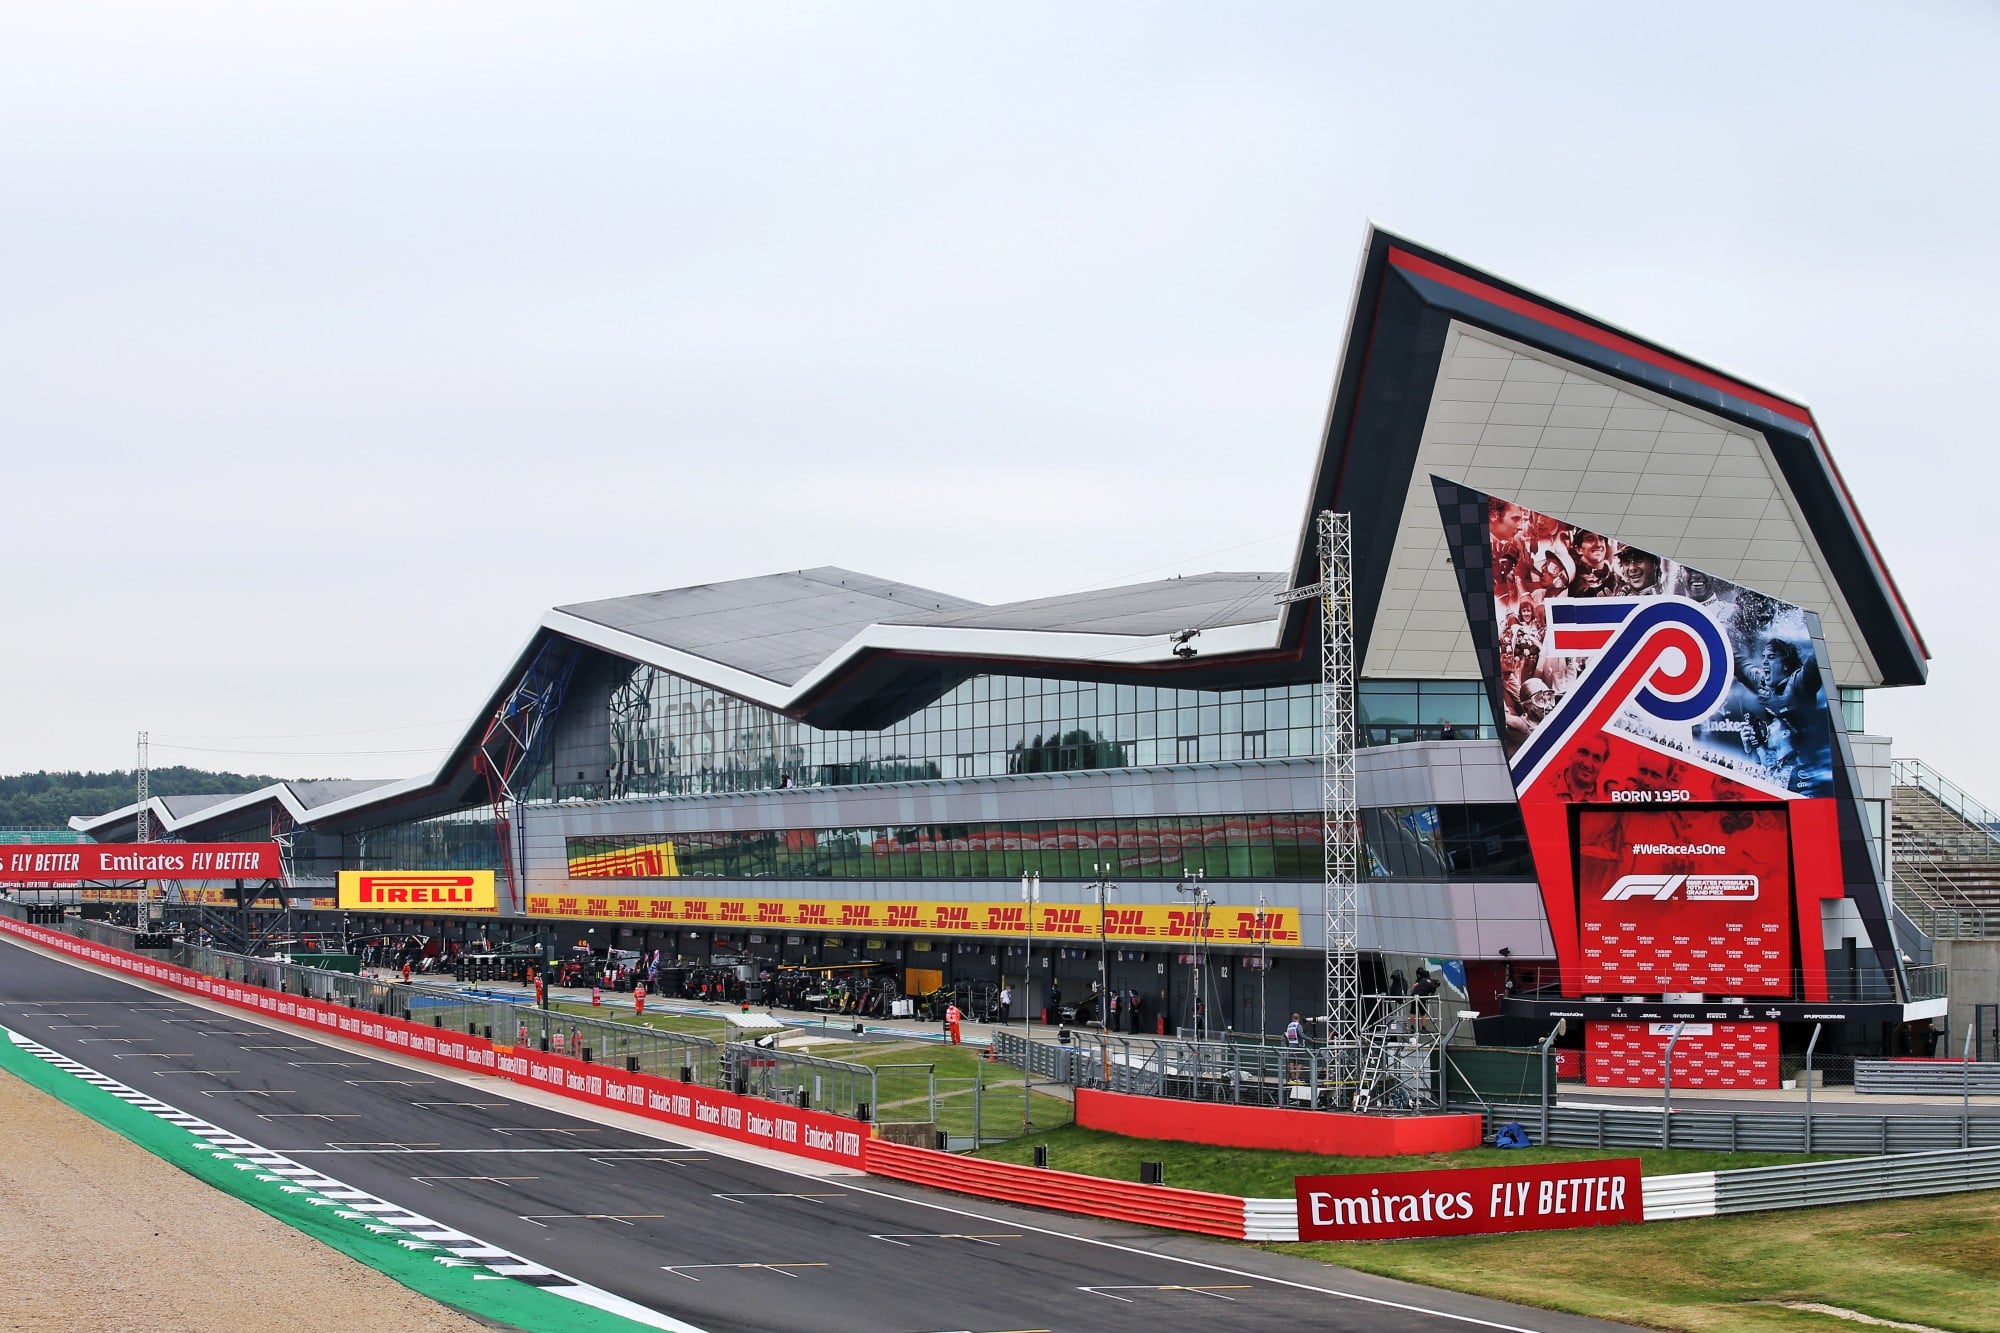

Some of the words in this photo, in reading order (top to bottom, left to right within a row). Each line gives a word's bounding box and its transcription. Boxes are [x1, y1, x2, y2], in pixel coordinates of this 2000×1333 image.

[1612, 790, 1652, 802] BORN
[1655, 790, 1690, 802] 1950
[1632, 844, 1726, 854] #WeRaceAsOne
[11, 854, 31, 872] FLY
[34, 853, 80, 871] BETTER
[100, 852, 184, 871] Emirates
[192, 853, 212, 871] FLY
[215, 852, 260, 870] BETTER
[360, 876, 474, 902] PIRELLI
[531, 898, 552, 914] DHL
[558, 898, 579, 915] DHL
[588, 899, 610, 916] DHL
[618, 900, 641, 918] DHL
[651, 901, 674, 919] DHL
[684, 902, 708, 920] DHL
[720, 902, 746, 921] DHL
[758, 903, 786, 922] DHL
[799, 904, 828, 924] DHL
[842, 905, 872, 926] DHL
[888, 906, 921, 928] DHL
[936, 907, 972, 929] DHL
[988, 908, 1026, 931] DHL
[1044, 909, 1084, 933] DHL
[1104, 910, 1147, 934] DHL
[1168, 912, 1214, 938] DHL
[1237, 912, 1288, 940] DHL
[649, 1089, 670, 1112] Emirates
[696, 1100, 719, 1124] Emirates
[748, 1112, 773, 1138] Emirates
[805, 1124, 833, 1151] Emirates
[843, 1132, 859, 1156] BETTER
[1308, 1188, 1474, 1226] Emirates
[1490, 1182, 1530, 1218] FLY
[1538, 1176, 1626, 1216] BETTER
